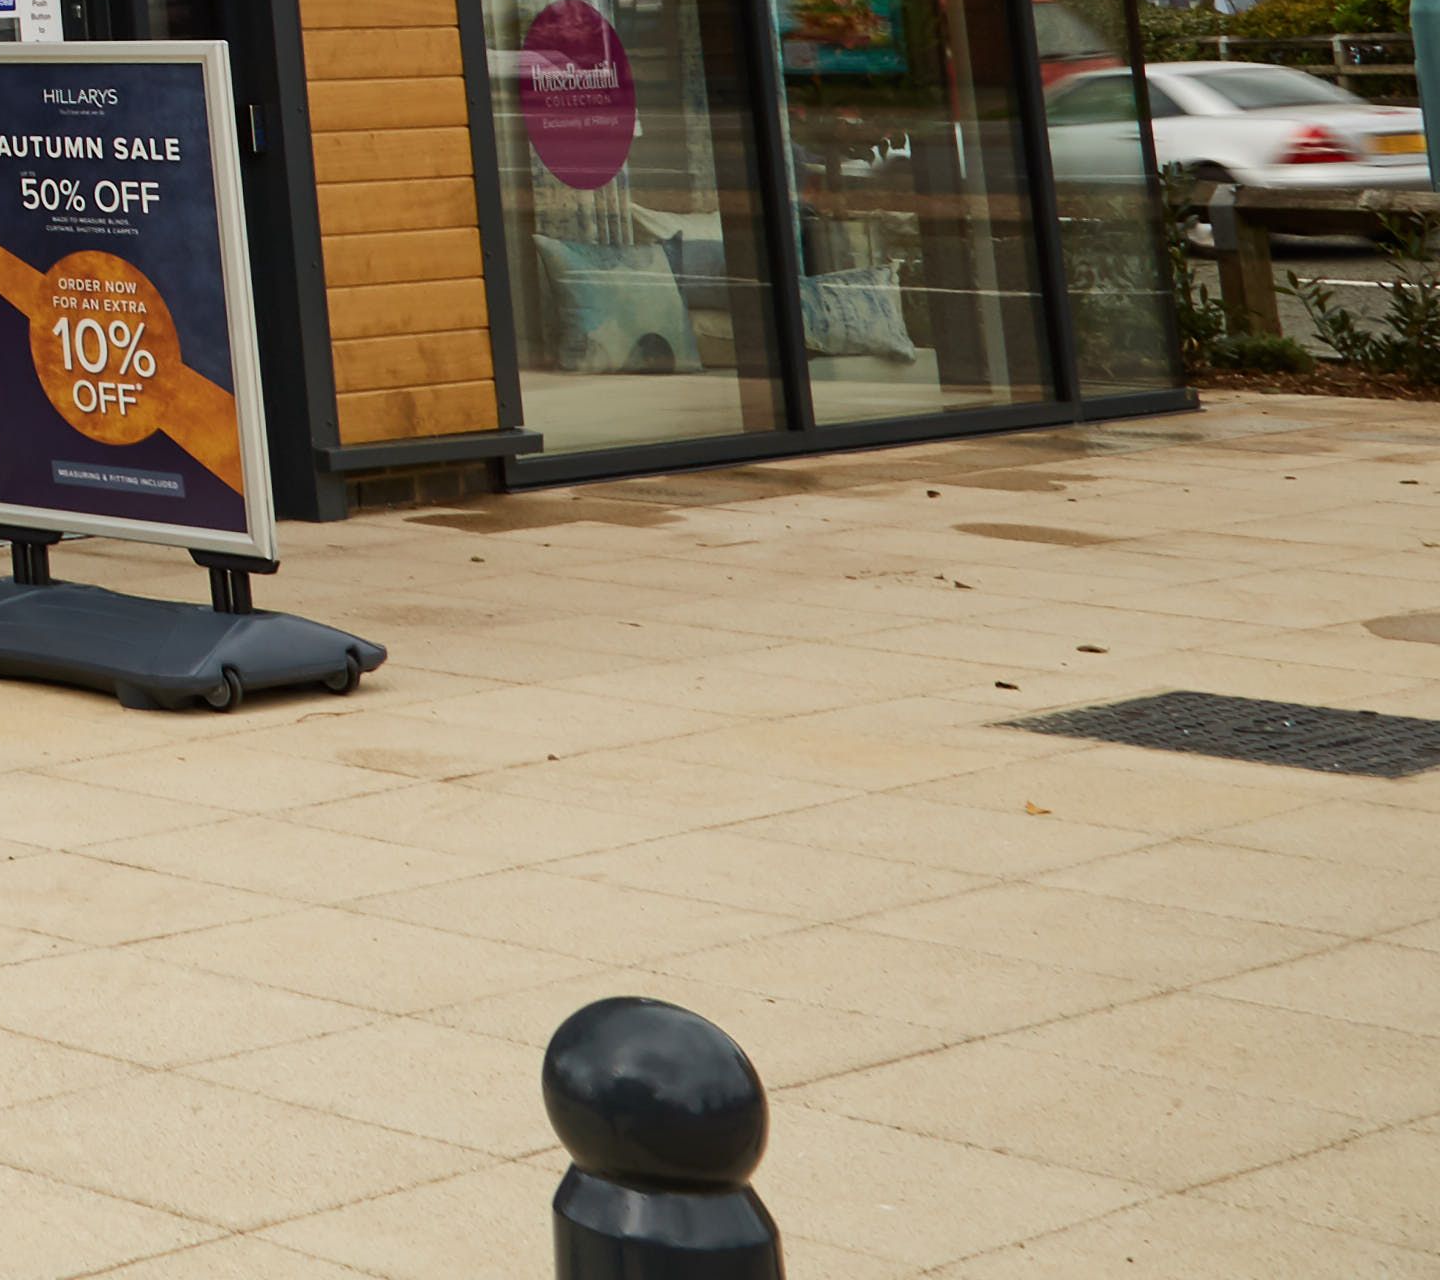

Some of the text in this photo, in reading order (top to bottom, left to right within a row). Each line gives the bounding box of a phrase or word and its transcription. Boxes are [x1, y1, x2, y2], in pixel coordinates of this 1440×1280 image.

[43, 88, 118, 108] HILLARYS
[545, 93, 611, 108] COLLECTION
[113, 137, 181, 161] SALE
[21, 178, 161, 214] 50% OFF
[58, 278, 137, 294] ORDER NOW
[52, 296, 147, 314] FOR AN EXTRA
[52, 316, 156, 378] 10%
[58, 469, 100, 481] MEASURING
[140, 478, 178, 490] INCLUDED
